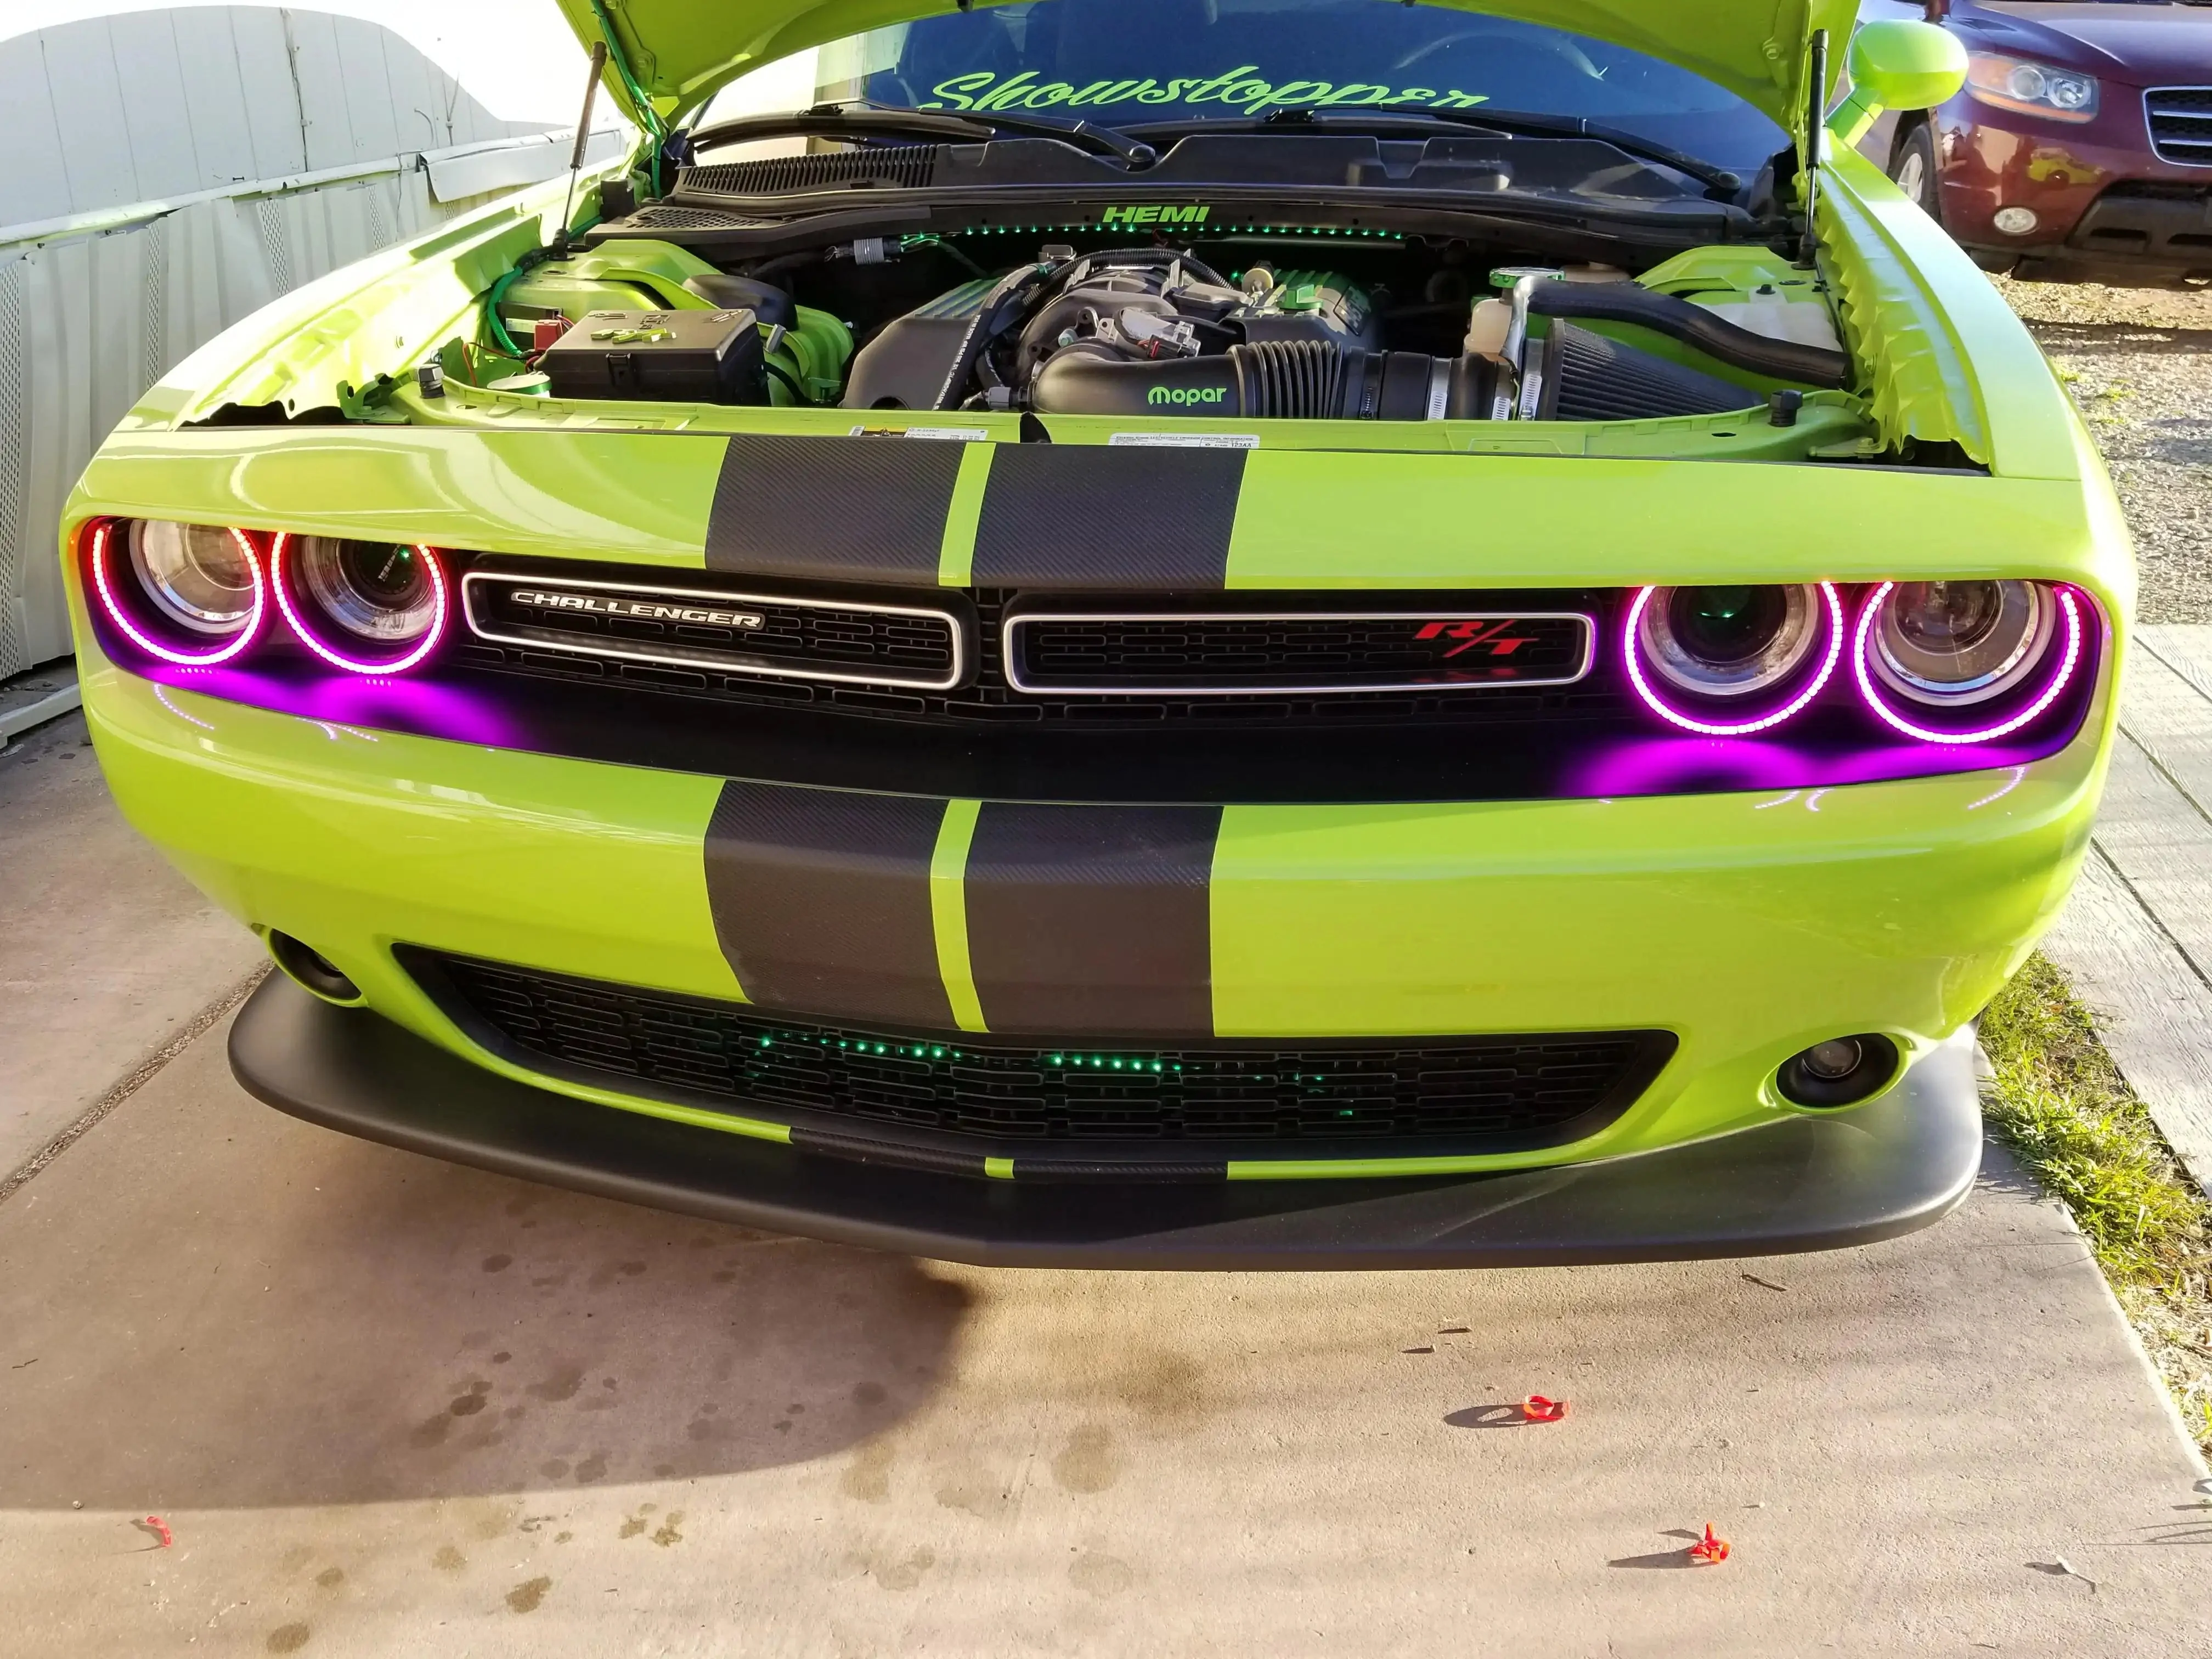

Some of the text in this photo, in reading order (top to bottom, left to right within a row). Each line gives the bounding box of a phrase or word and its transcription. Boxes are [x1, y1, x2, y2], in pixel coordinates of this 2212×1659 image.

[1102, 206, 1210, 223] HEMI
[511, 592, 761, 628] CHALLENGER
[1414, 619, 1539, 658] R/T
